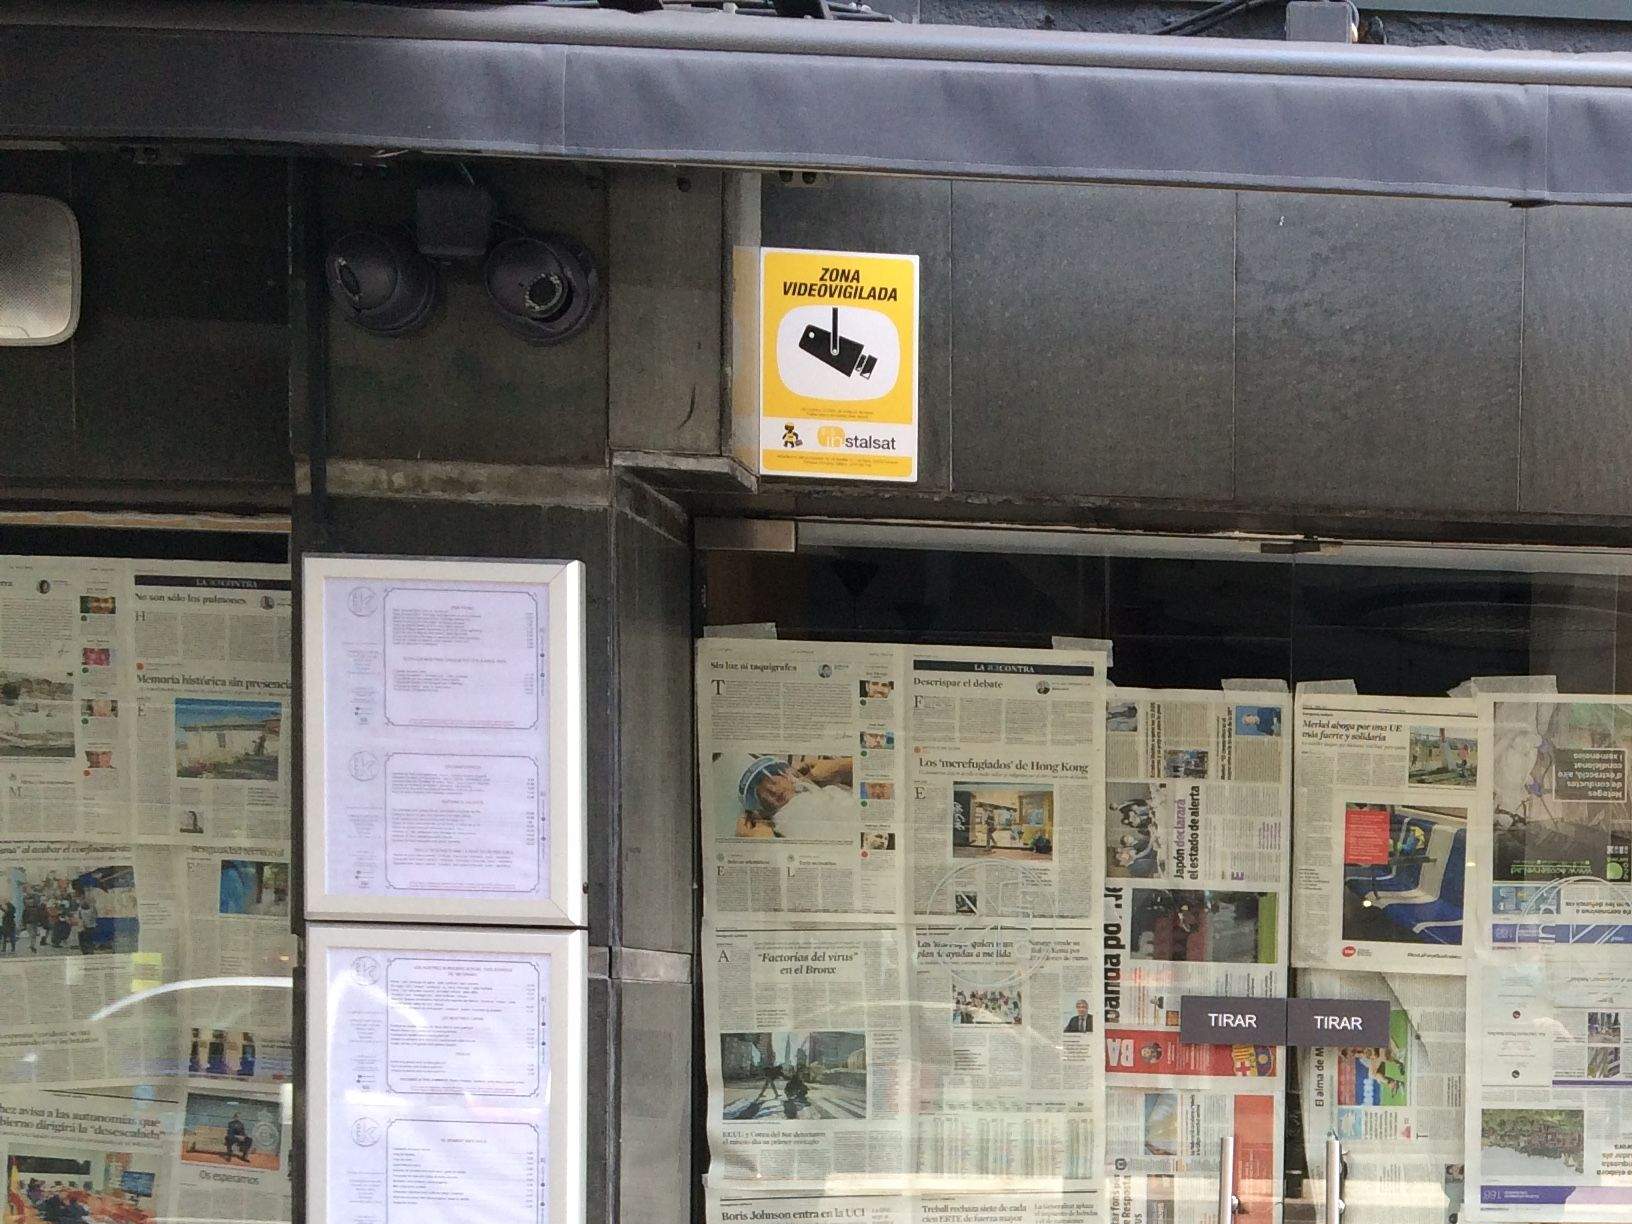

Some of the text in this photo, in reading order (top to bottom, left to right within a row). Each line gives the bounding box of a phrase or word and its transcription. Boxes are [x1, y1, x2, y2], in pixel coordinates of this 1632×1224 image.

[819, 268, 860, 284] ZONA
[783, 282, 898, 302] VIDEOVIGILADA
[1173, 799, 1186, 880] Japón declarará
[1188, 786, 1200, 880] el estado de alerta
[780, 965, 836, 974] en el Bronx
[1208, 1013, 1257, 1028] TIRAR
[1314, 1016, 1362, 1031] TIRAR
[721, 1211, 748, 1221] Boris
[750, 1209, 791, 1220] Johnson
[796, 1211, 819, 1219] entra
[834, 1207, 845, 1218] la
[846, 1207, 865, 1217] UCI
